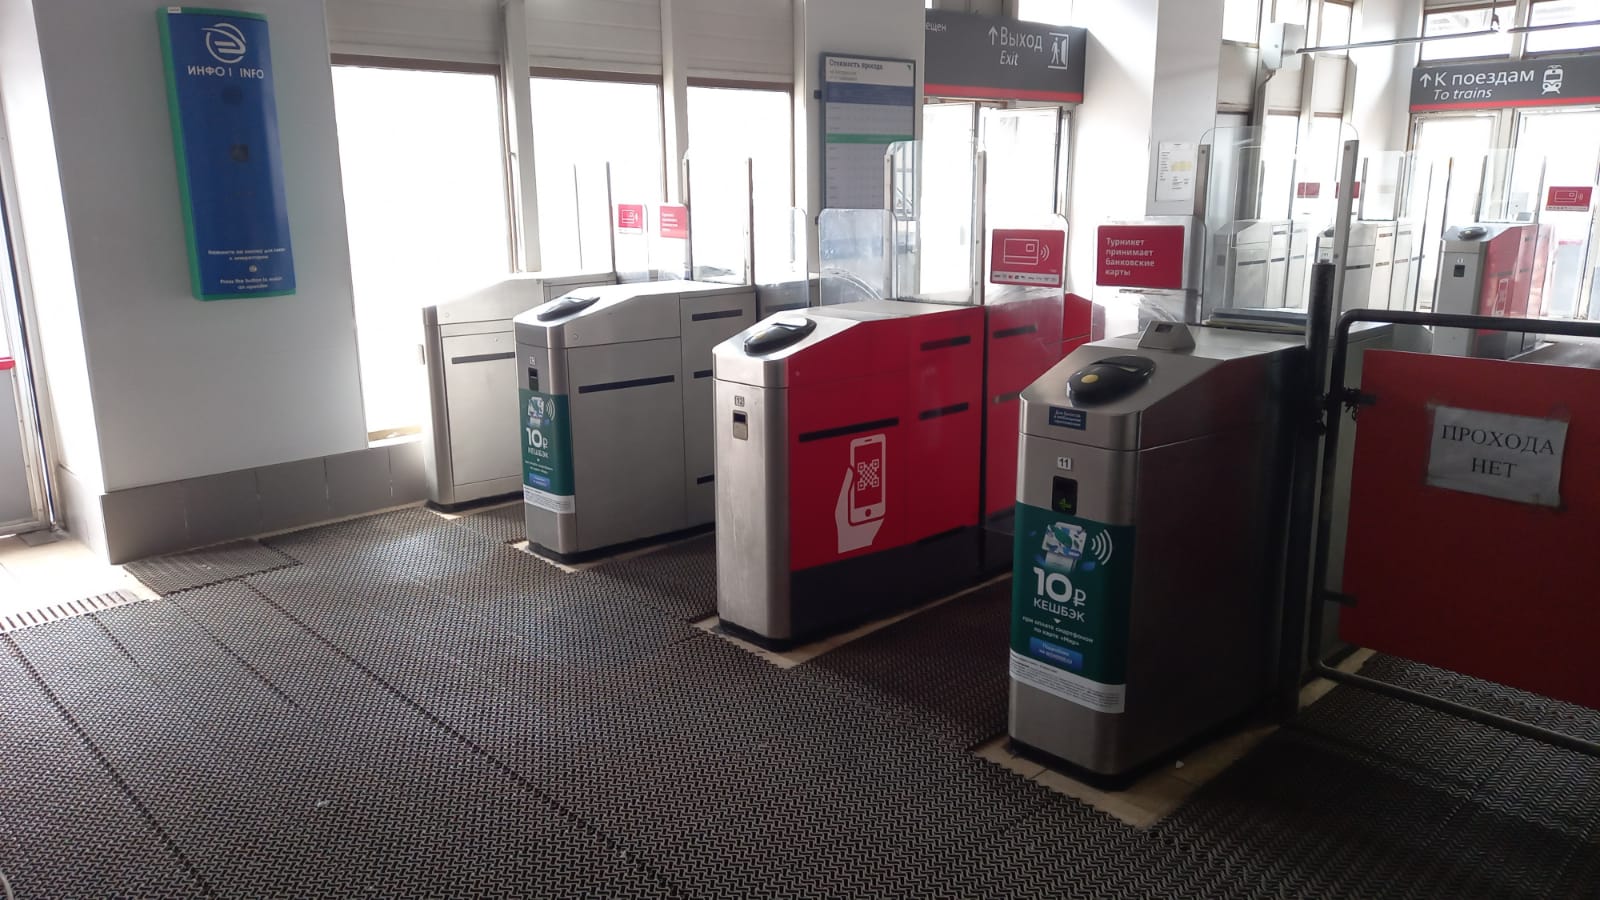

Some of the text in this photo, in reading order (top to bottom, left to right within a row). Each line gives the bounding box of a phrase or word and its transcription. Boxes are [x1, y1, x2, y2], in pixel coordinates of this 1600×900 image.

[1000, 26, 1043, 52] Выход
[1000, 50, 1019, 66] Exit
[187, 65, 225, 77] ИНФО
[240, 68, 264, 79] INFO
[1434, 70, 1535, 86] К поездам
[1433, 88, 1493, 100] To trains
[1105, 237, 1144, 247] Турникет
[1105, 249, 1154, 257] принимает
[1105, 258, 1155, 267] банковские
[1105, 269, 1131, 277] карты
[1441, 424, 1555, 455] ПРОХОДА
[1059, 458, 1069, 468] 11
[1471, 457, 1518, 478] НЕТ
[1033, 597, 1086, 622] КЕШБЭК
